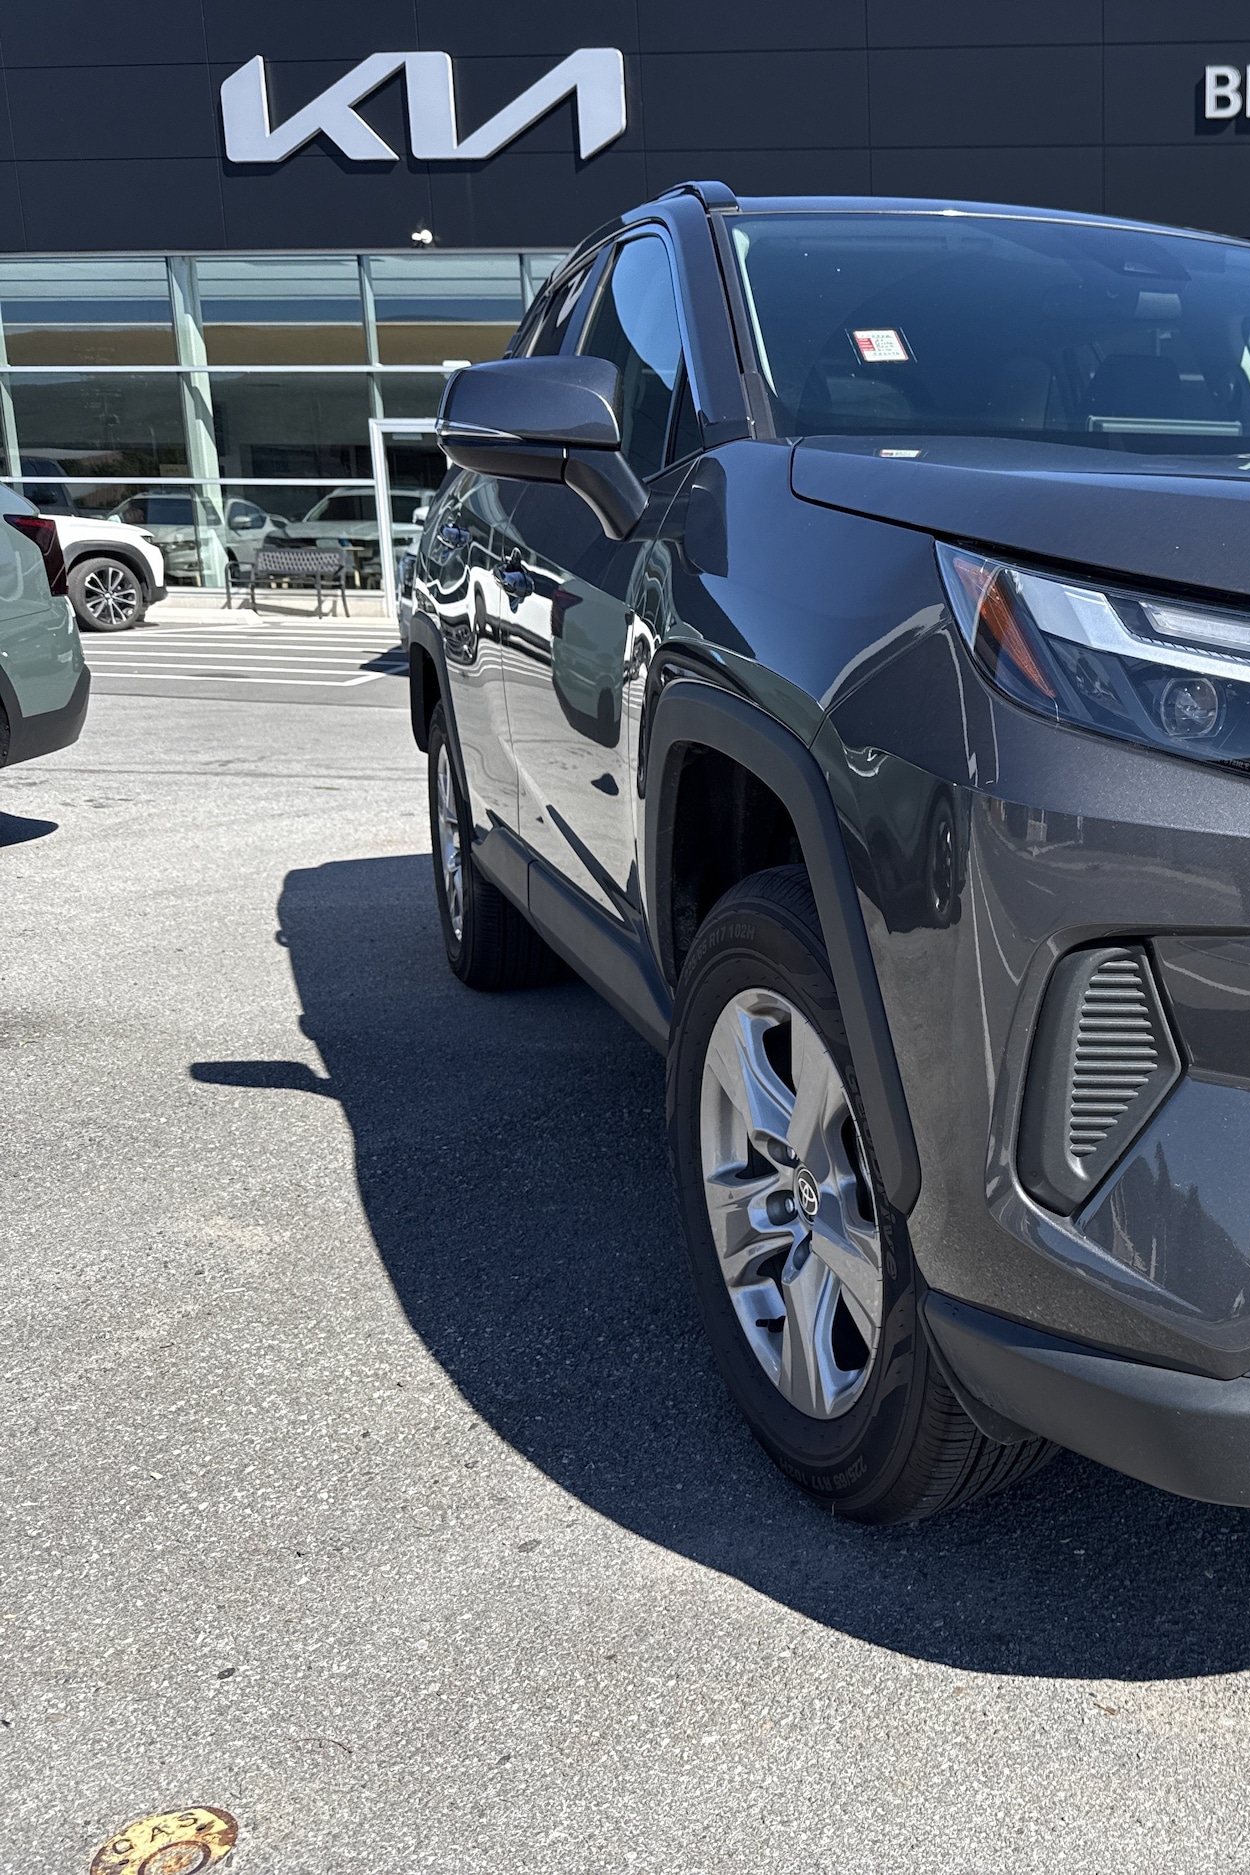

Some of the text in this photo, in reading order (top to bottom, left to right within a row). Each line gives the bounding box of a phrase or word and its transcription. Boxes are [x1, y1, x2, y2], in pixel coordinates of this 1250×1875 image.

[220, 47, 628, 163] KIA
[729, 923, 756, 941] 102H
[812, 1475, 833, 1492] R17
[833, 1454, 868, 1490] 225/65
